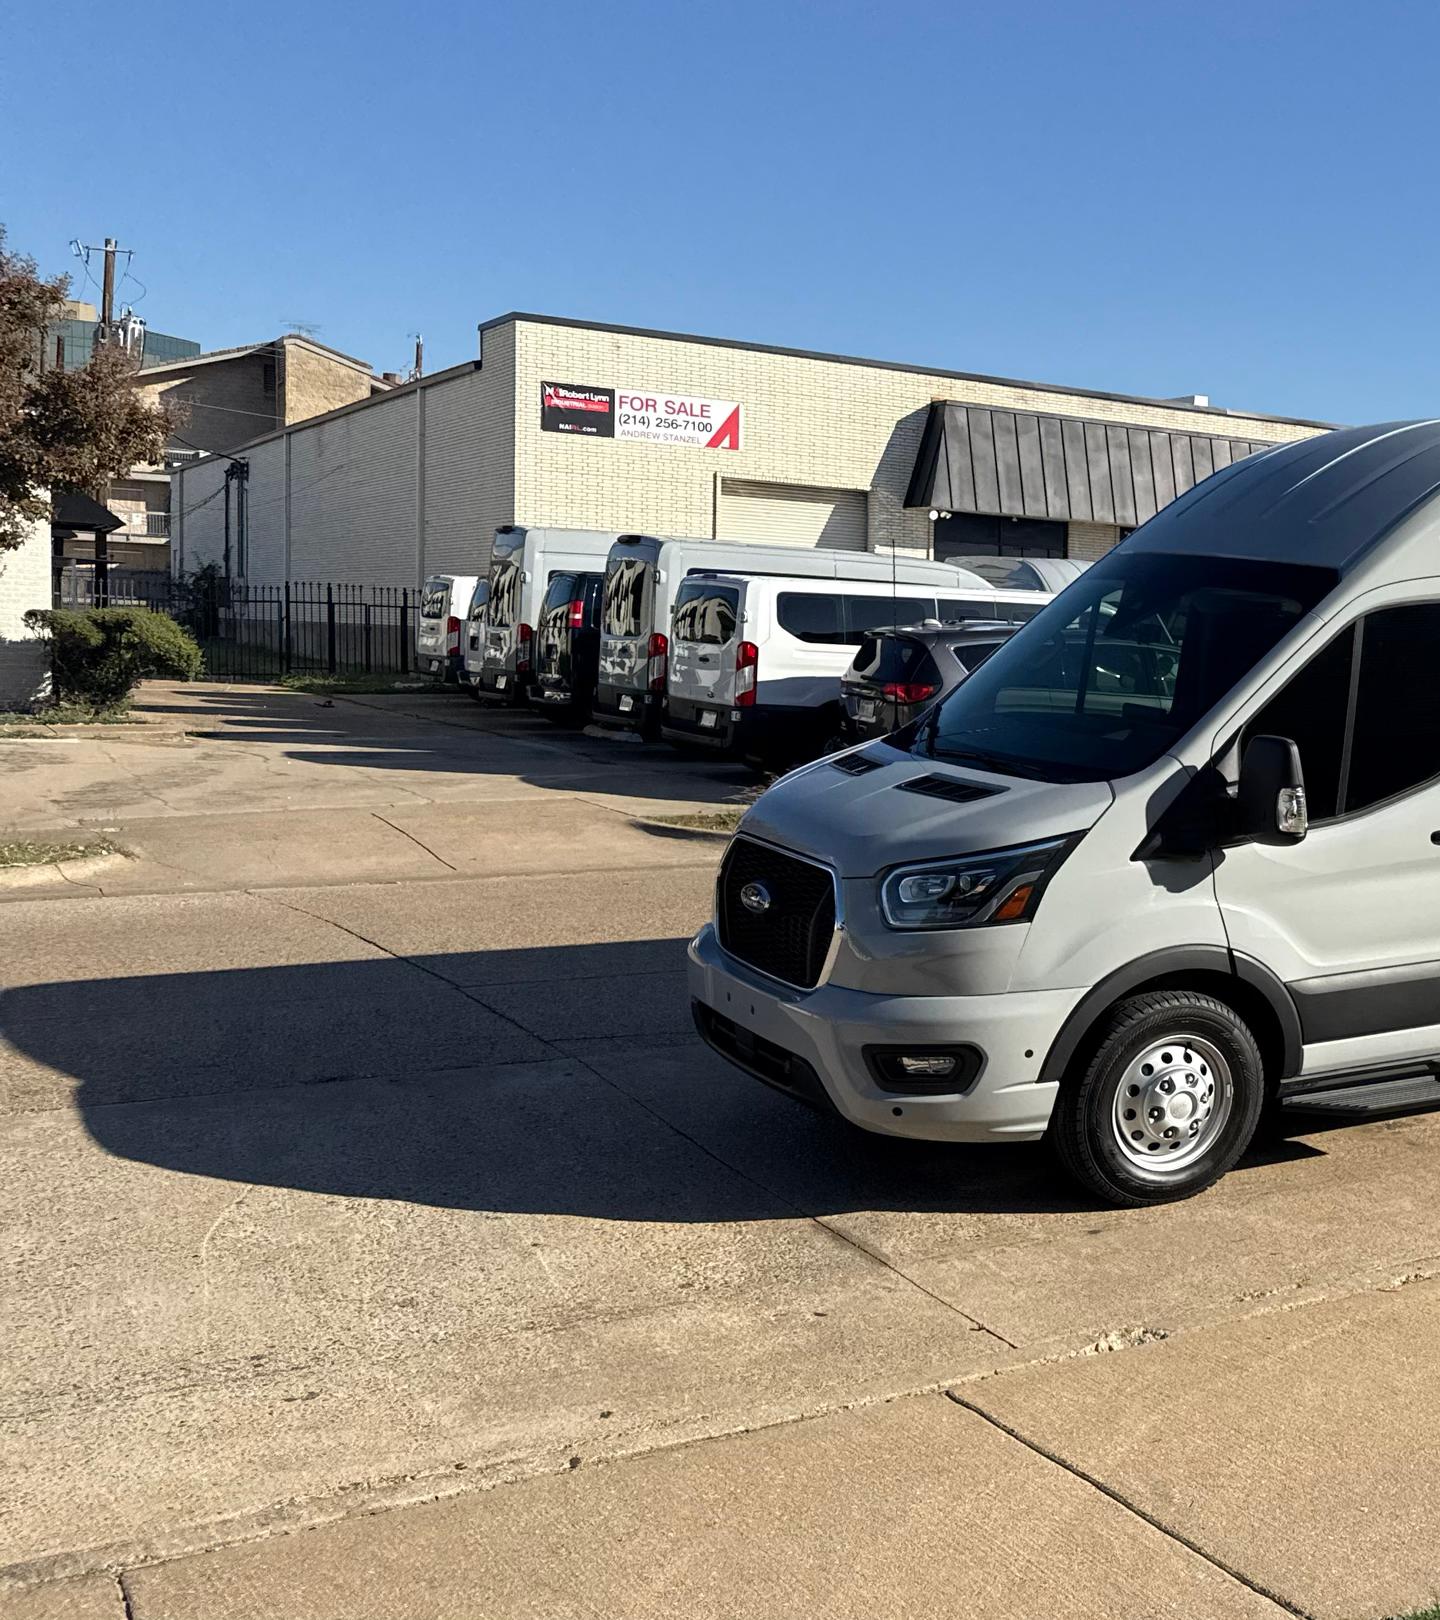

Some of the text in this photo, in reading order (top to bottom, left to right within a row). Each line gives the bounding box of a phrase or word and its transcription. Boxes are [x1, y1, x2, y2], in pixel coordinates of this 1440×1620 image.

[562, 389, 589, 399] Robert
[590, 393, 609, 402] Lynn
[619, 395, 711, 418] FOR SALE
[618, 413, 713, 432] (214) 256-7100
[620, 429, 702, 444] ANDREW STANZEL
